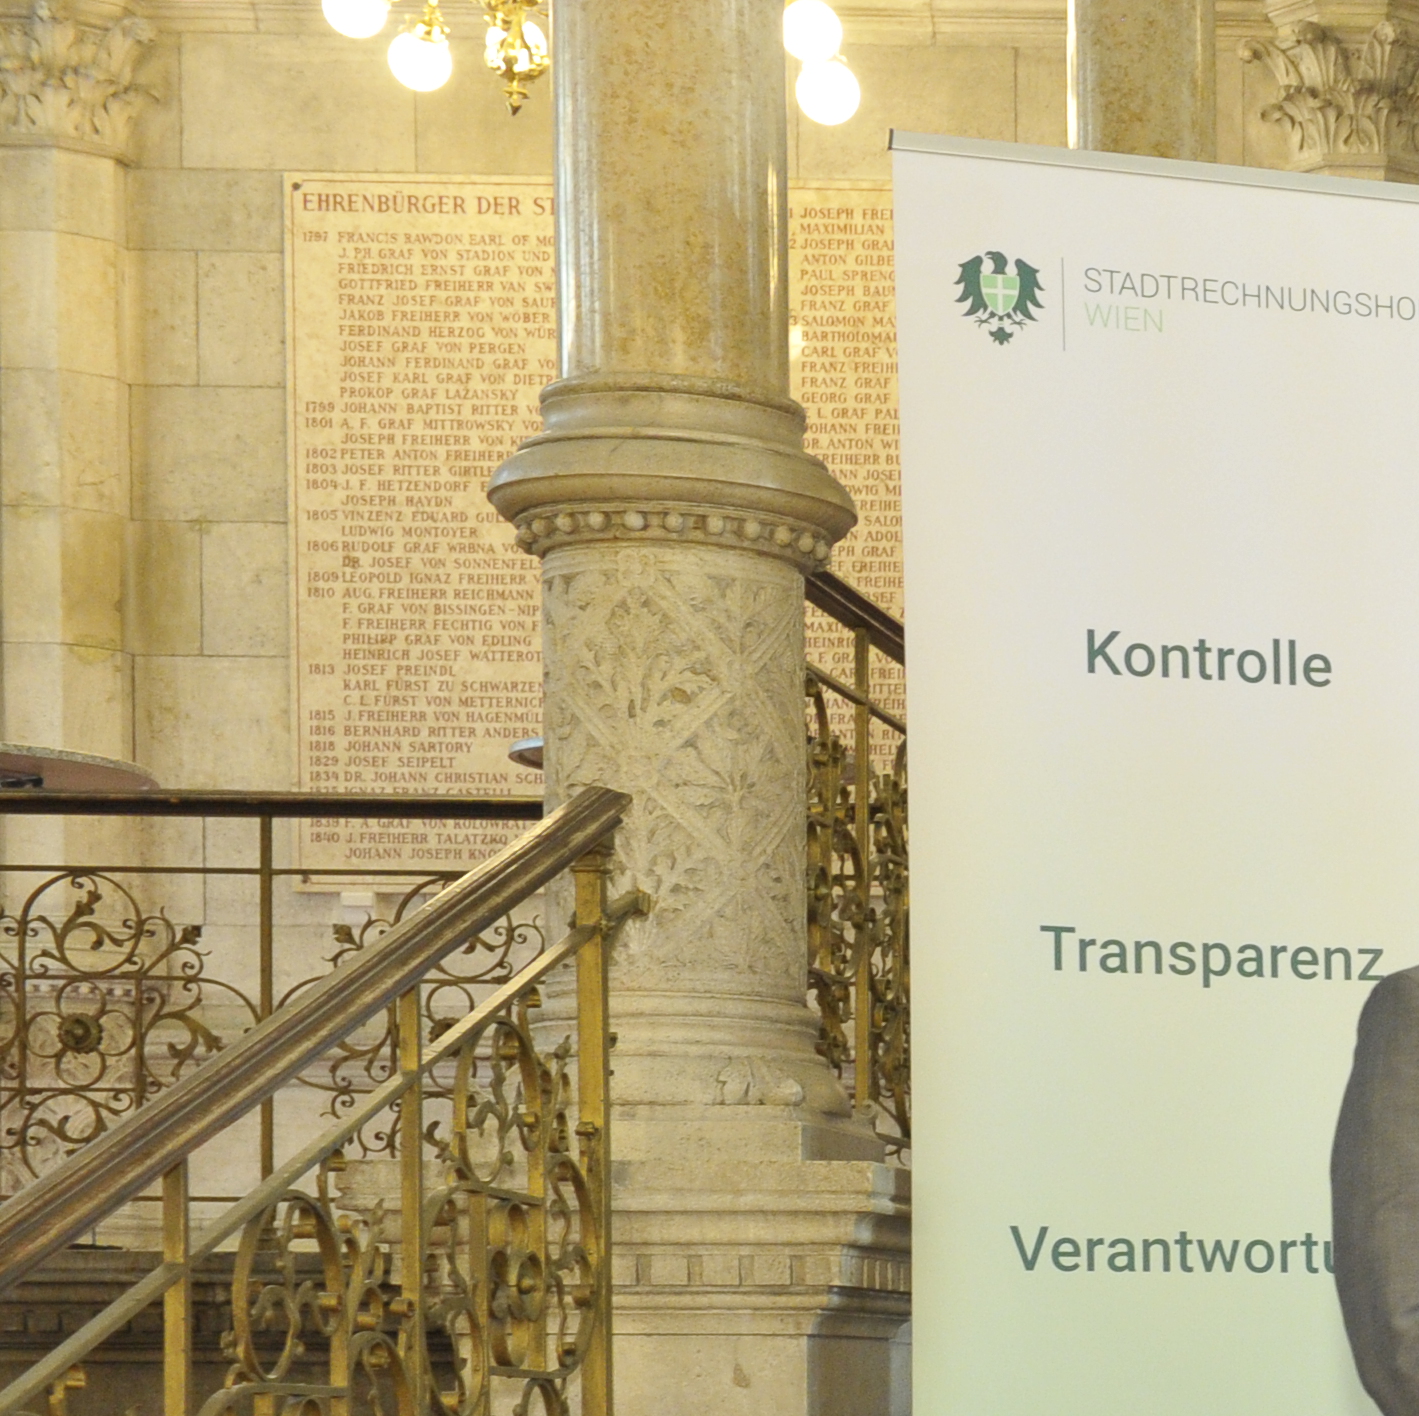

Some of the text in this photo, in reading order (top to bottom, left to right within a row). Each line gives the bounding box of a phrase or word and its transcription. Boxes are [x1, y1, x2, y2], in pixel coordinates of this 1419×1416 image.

[302, 190, 521, 215] EHRENBÜRGER DER
[799, 207, 855, 220] JOSEPH
[800, 222, 886, 236] MAXIMILIAN
[302, 231, 329, 242] 1797
[338, 231, 398, 244] FRANCIS
[469, 233, 505, 246] EARL
[511, 234, 530, 246] OF
[799, 238, 855, 251] JOSEPH
[378, 248, 551, 263] GRAF VON STADION UND
[800, 253, 847, 267] ANTON
[338, 262, 543, 278] FRIEDRICH ERNST GRAF VON
[800, 269, 837, 282] PAUL
[338, 278, 526, 293] GOTTFRIED FREIHERR VAN
[800, 284, 855, 297] JOSEPH
[338, 293, 515, 308] FRANZ JOSEF GRAF VON
[800, 299, 890, 313] FRANZ GRAF
[338, 308, 494, 323] JAKOB FREIHERR VON
[801, 315, 867, 328] SALOMON
[1084, 301, 1164, 333] WIEN
[338, 324, 518, 339] FERDINAND HERZOG VON
[339, 340, 526, 355] JOSEF GRAF VON PERGEN
[801, 345, 881, 359] CARL GRAF
[339, 355, 529, 371] JOHANN FERDINAND GRAF
[801, 361, 847, 374] FRANZ
[340, 370, 506, 386] JOSEF KARL GRAF VON
[801, 376, 892, 390] FRANZ GRAF
[339, 386, 438, 400] PROKOP GRAF
[801, 391, 892, 405] GEORG GRAF
[305, 401, 519, 416] 1799 JOHANN BAPTIST RITTER
[831, 407, 869, 420] GRAF
[305, 416, 515, 432] 1801 GRAF MITTROWSKY
[340, 432, 505, 447] JOSEPH FREIHERR VON
[826, 438, 874, 451] ANTON
[305, 448, 438, 461] 1802 PETER ANTON
[305, 463, 441, 477] 1803 JOSEF RITTER
[305, 478, 471, 493] 1804 HETZENDORF
[341, 494, 453, 508] JOSEPH HAYDN
[306, 509, 469, 524] 1805 VINZENZ EDUARD
[341, 525, 478, 539] LUDWIG MONTOYER
[306, 540, 496, 555] 1806 RUDOLF GRAF WRBNA
[861, 545, 897, 558] GRAF
[368, 556, 447, 570] JOSEF VON
[307, 570, 527, 586] 1809 LEOPOLD IGNAZ FREIHERR
[307, 586, 535, 602] 1810 FREIHERR REICHMANN
[357, 602, 428, 615] GRAF VON
[357, 617, 526, 632] FREIHERR FECHTIG VON
[342, 632, 532, 648] PHILIPP GRAF VON EDLING
[342, 648, 461, 662] HEINRICH JOSEF
[1085, 628, 1333, 688] Kontrolle
[308, 663, 457, 677] 1813 JOSEF PREINDL
[342, 678, 380, 692] KARL
[437, 680, 454, 693] ZU
[425, 695, 452, 708] VON
[309, 709, 460, 723] 1815 FREIHERR VON
[309, 724, 540, 739] 1816 BERNHARD RITTER ANDERS
[309, 740, 473, 755] 1818 JOHANN SARTORY
[309, 755, 456, 770] 1829 JOSEF SEIPELT
[310, 770, 508, 785] 1834 JOHANN CHRISTIAN
[310, 831, 428, 845] 1840 FREIHERR
[344, 846, 462, 861] JOHANN JOSEPH
[1039, 924, 1387, 989] Transparenz
